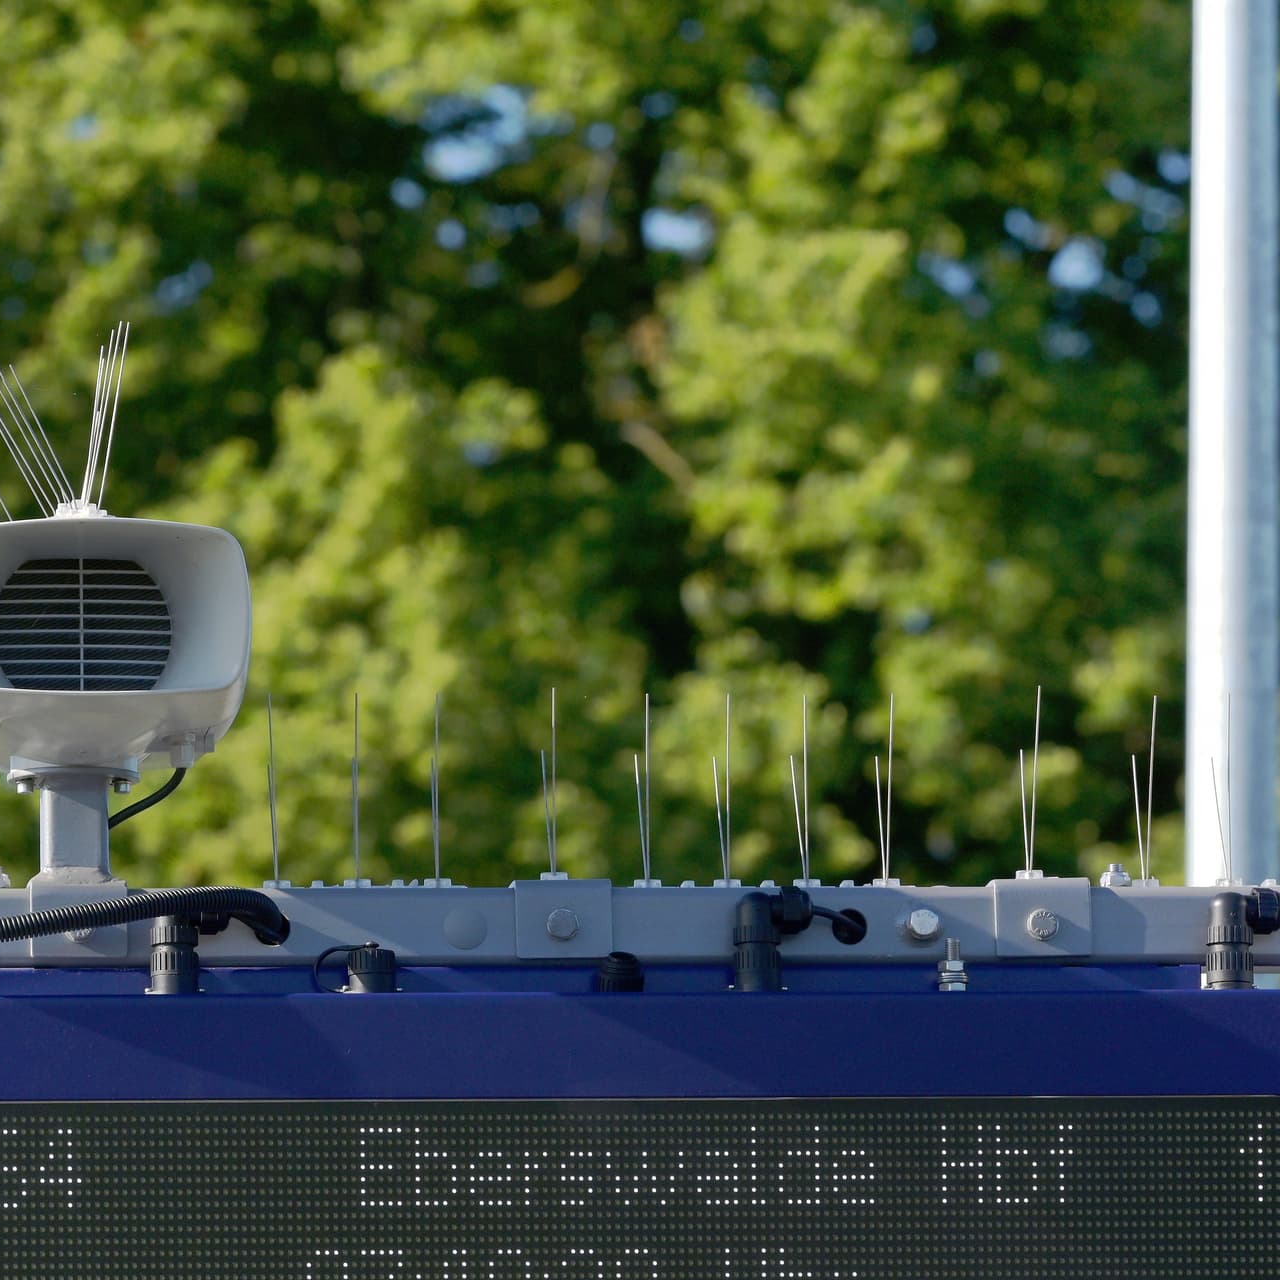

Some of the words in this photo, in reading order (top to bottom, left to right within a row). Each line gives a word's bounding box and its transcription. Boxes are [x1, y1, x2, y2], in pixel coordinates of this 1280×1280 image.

[358, 1125, 876, 1207] Eberswalde
[940, 1123, 1075, 1204] Hbf
[1238, 1122, 1265, 1202] 1
